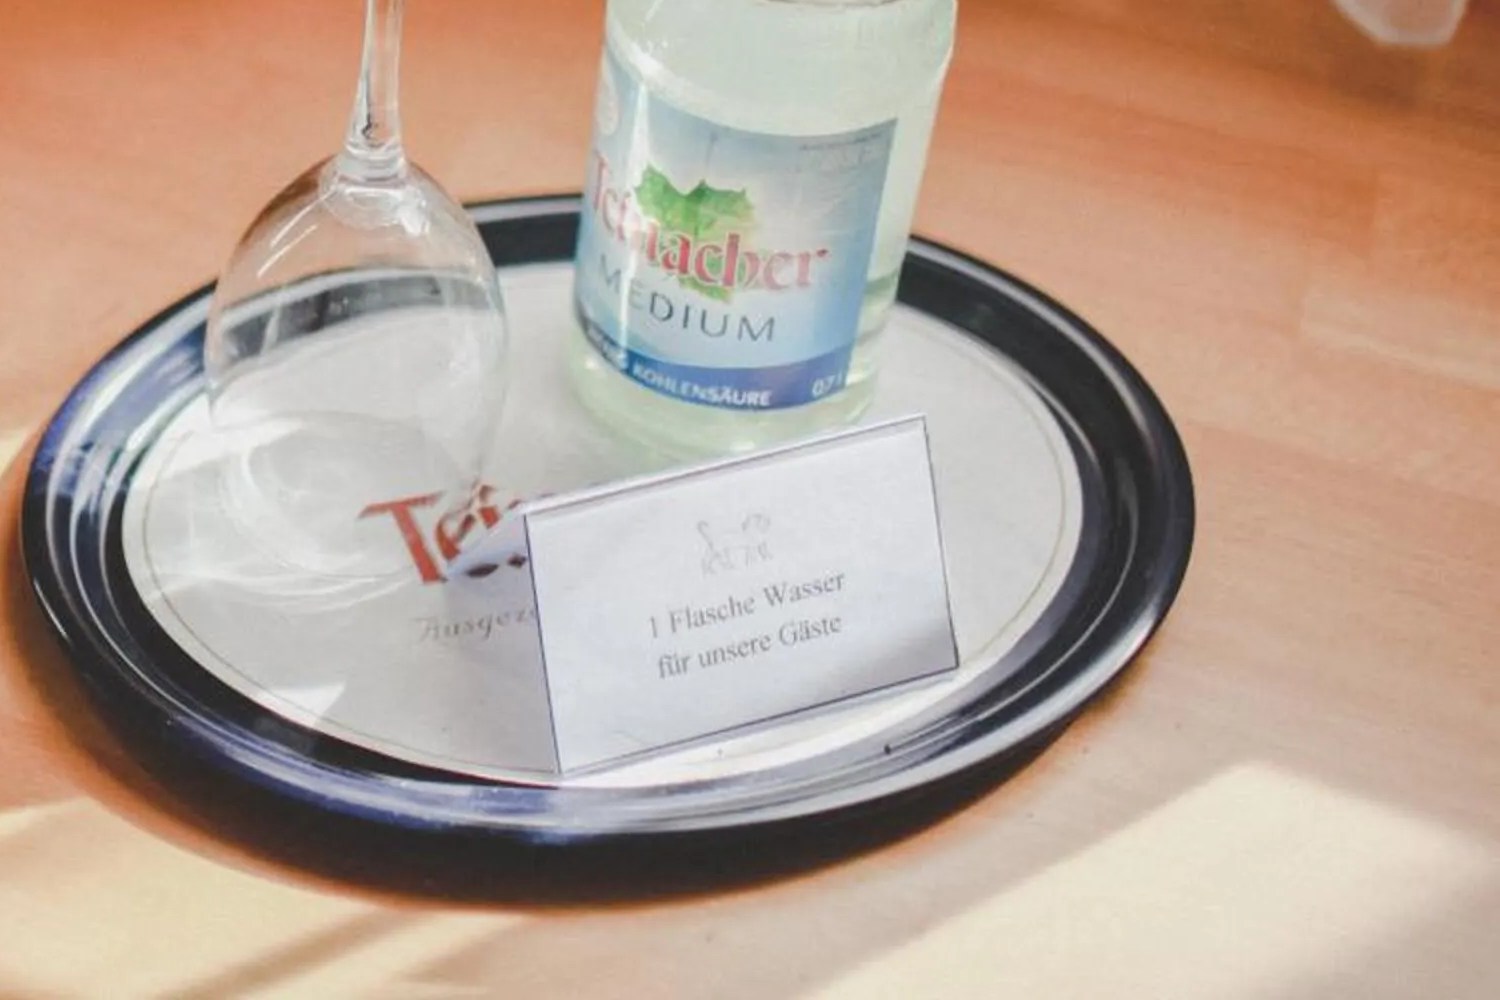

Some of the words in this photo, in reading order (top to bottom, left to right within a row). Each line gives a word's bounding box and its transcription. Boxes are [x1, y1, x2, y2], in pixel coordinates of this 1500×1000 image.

[600, 252, 776, 342] MEDIUM
[632, 361, 772, 407] KOHLENSÄURE
[650, 615, 658, 639] 1
[668, 595, 756, 634] Flasche
[762, 572, 846, 609] Wasser
[658, 652, 691, 679] für
[697, 633, 772, 669] unsere
[778, 615, 843, 646] Gäste
